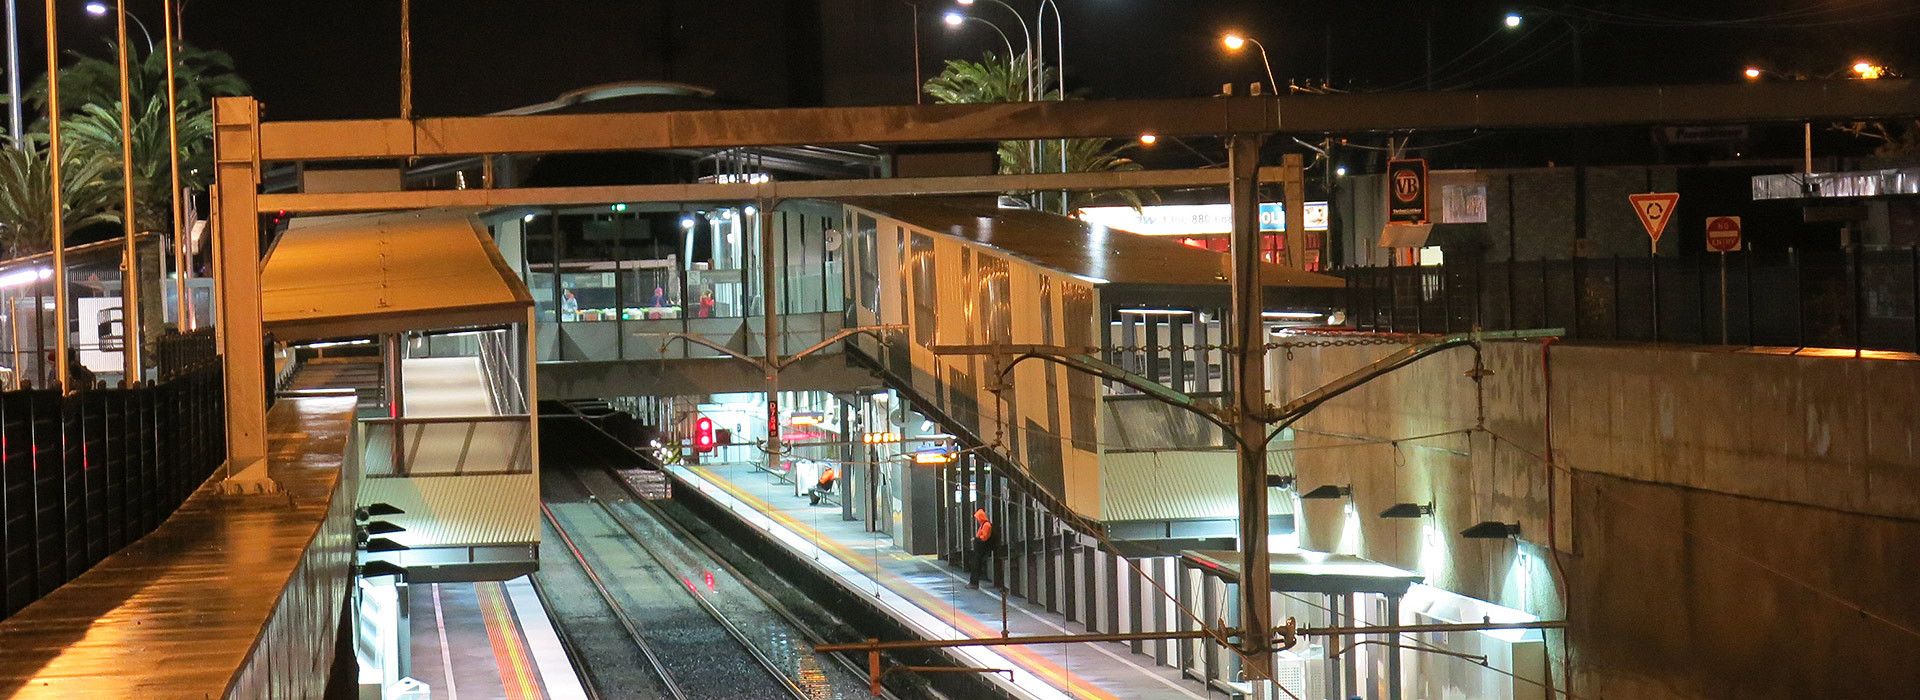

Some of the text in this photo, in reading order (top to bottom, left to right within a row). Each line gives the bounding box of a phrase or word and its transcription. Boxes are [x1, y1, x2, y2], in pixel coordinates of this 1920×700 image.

[1396, 178, 1418, 193] VB
[1718, 222, 1729, 230] NO
[1712, 238, 1736, 246] ENTRY
